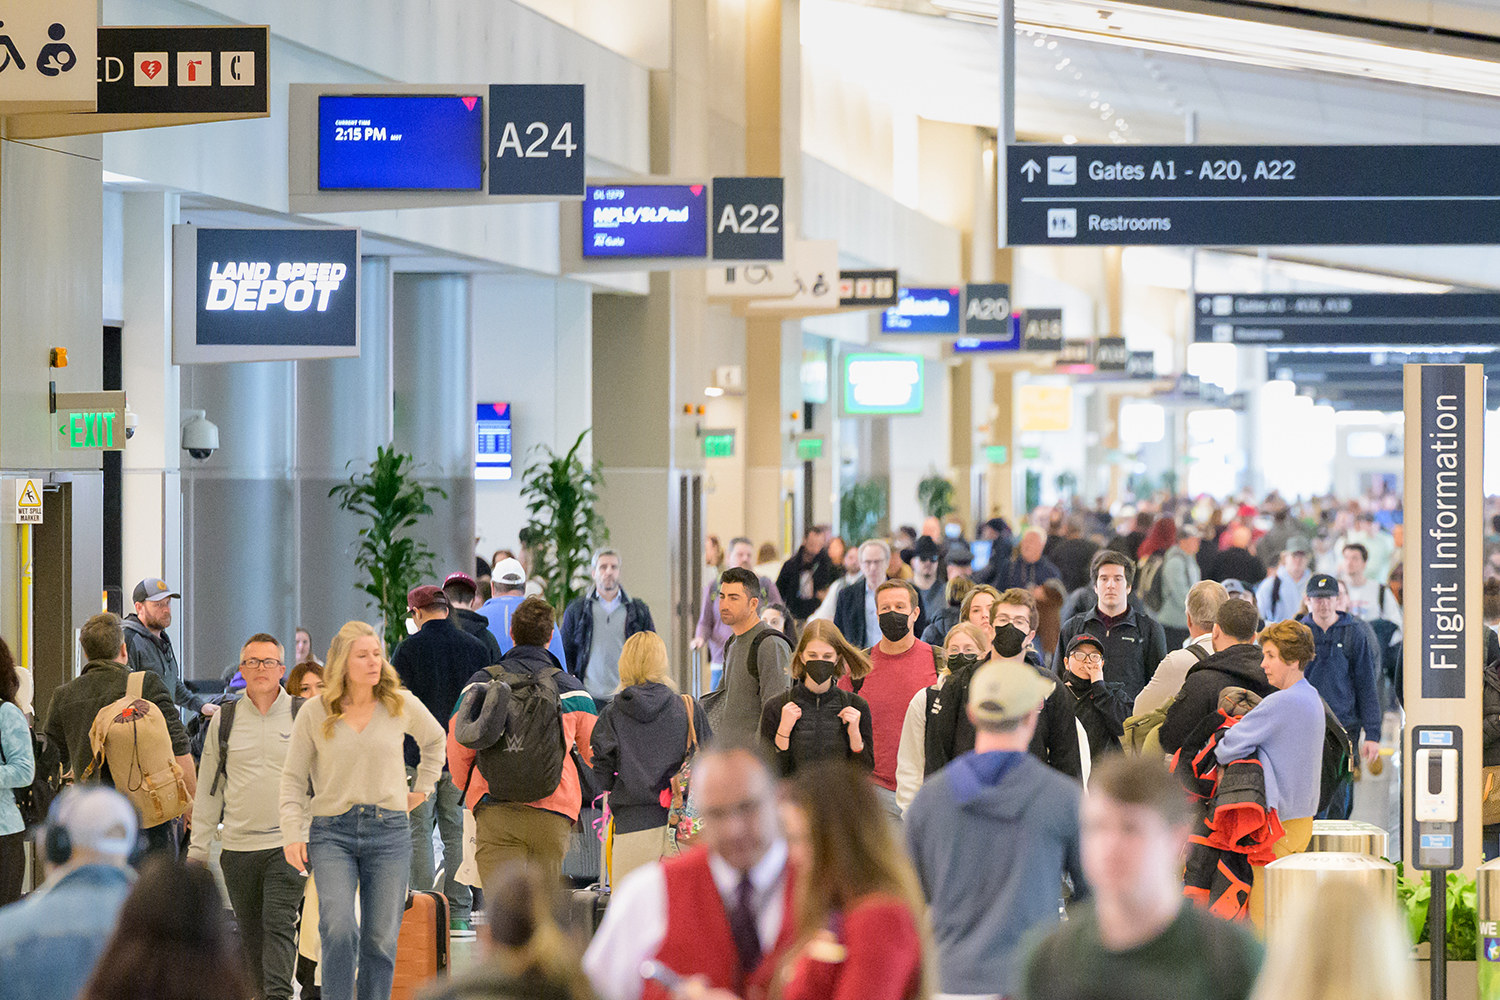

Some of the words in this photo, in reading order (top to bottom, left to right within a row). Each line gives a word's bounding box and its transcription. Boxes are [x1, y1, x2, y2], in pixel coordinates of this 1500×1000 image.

[335, 127, 362, 141] 2:15
[364, 127, 387, 141] PM
[496, 121, 577, 158] A24
[1088, 160, 1145, 180] Gates
[1150, 160, 1177, 180] A1
[1199, 160, 1248, 183] A20,
[1253, 160, 1297, 180] A22
[717, 203, 780, 234] A22
[1088, 214, 1172, 231] Restrooms
[209, 261, 271, 281] LAND
[276, 262, 347, 281] SPEED
[205, 279, 340, 312] DEPOT
[966, 297, 1010, 321] A20
[69, 412, 116, 447] EXIT
[1429, 394, 1458, 569] Information
[1429, 582, 1465, 670] Flight
[1479, 921, 1497, 936] WE
